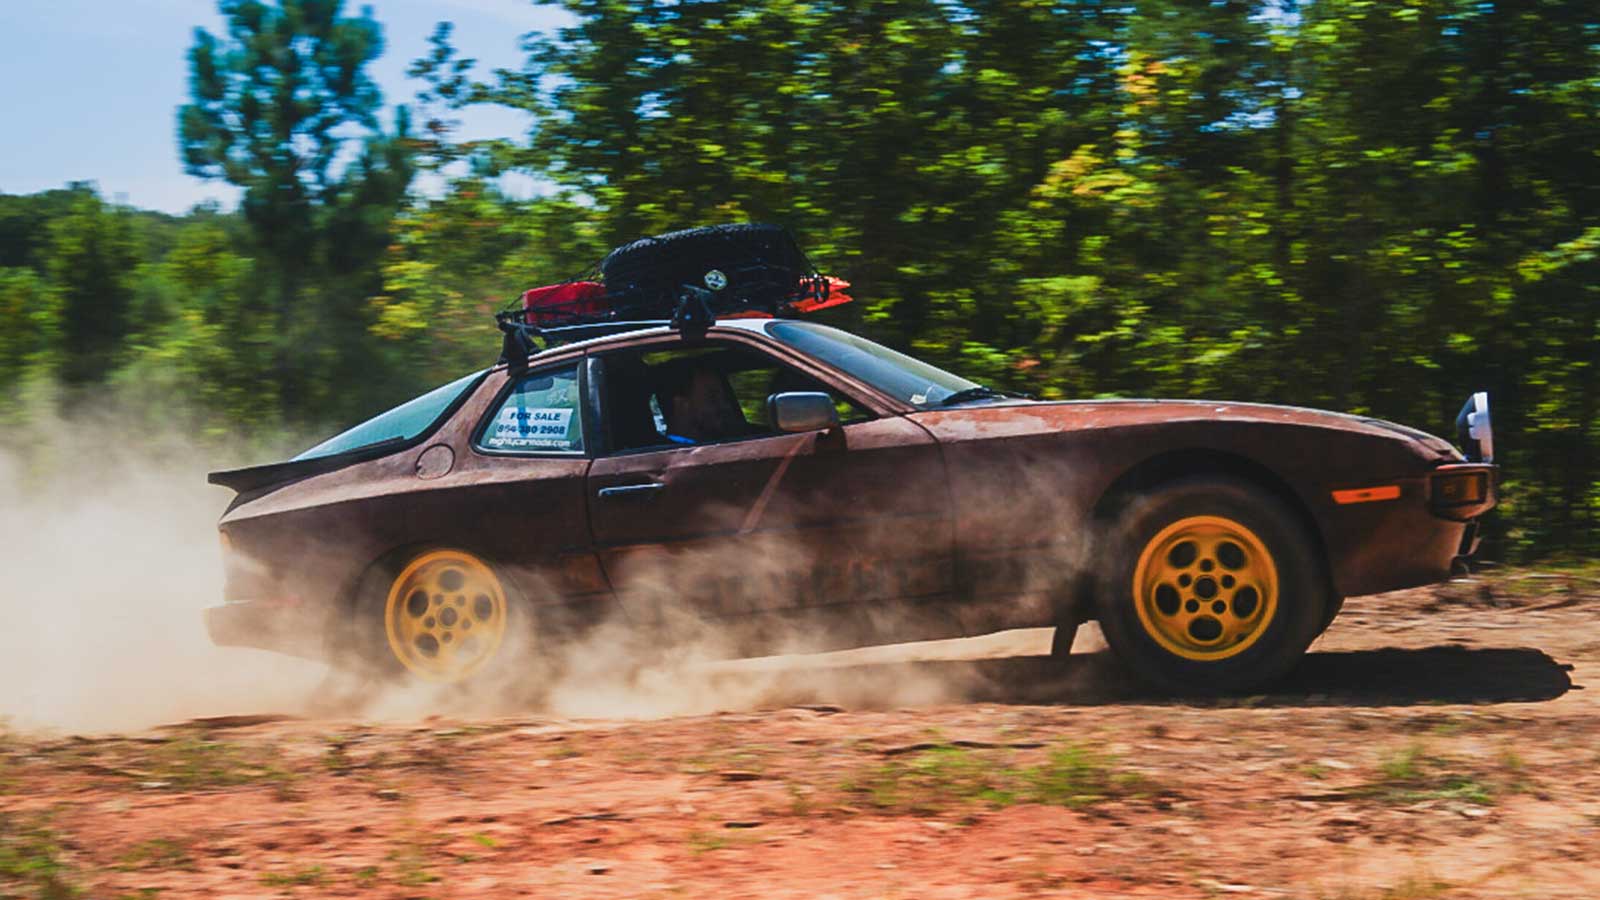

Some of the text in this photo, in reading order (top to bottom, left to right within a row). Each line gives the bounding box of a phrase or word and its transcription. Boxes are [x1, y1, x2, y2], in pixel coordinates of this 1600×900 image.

[510, 412, 561, 421] FOR SALE
[540, 425, 566, 434] 2908
